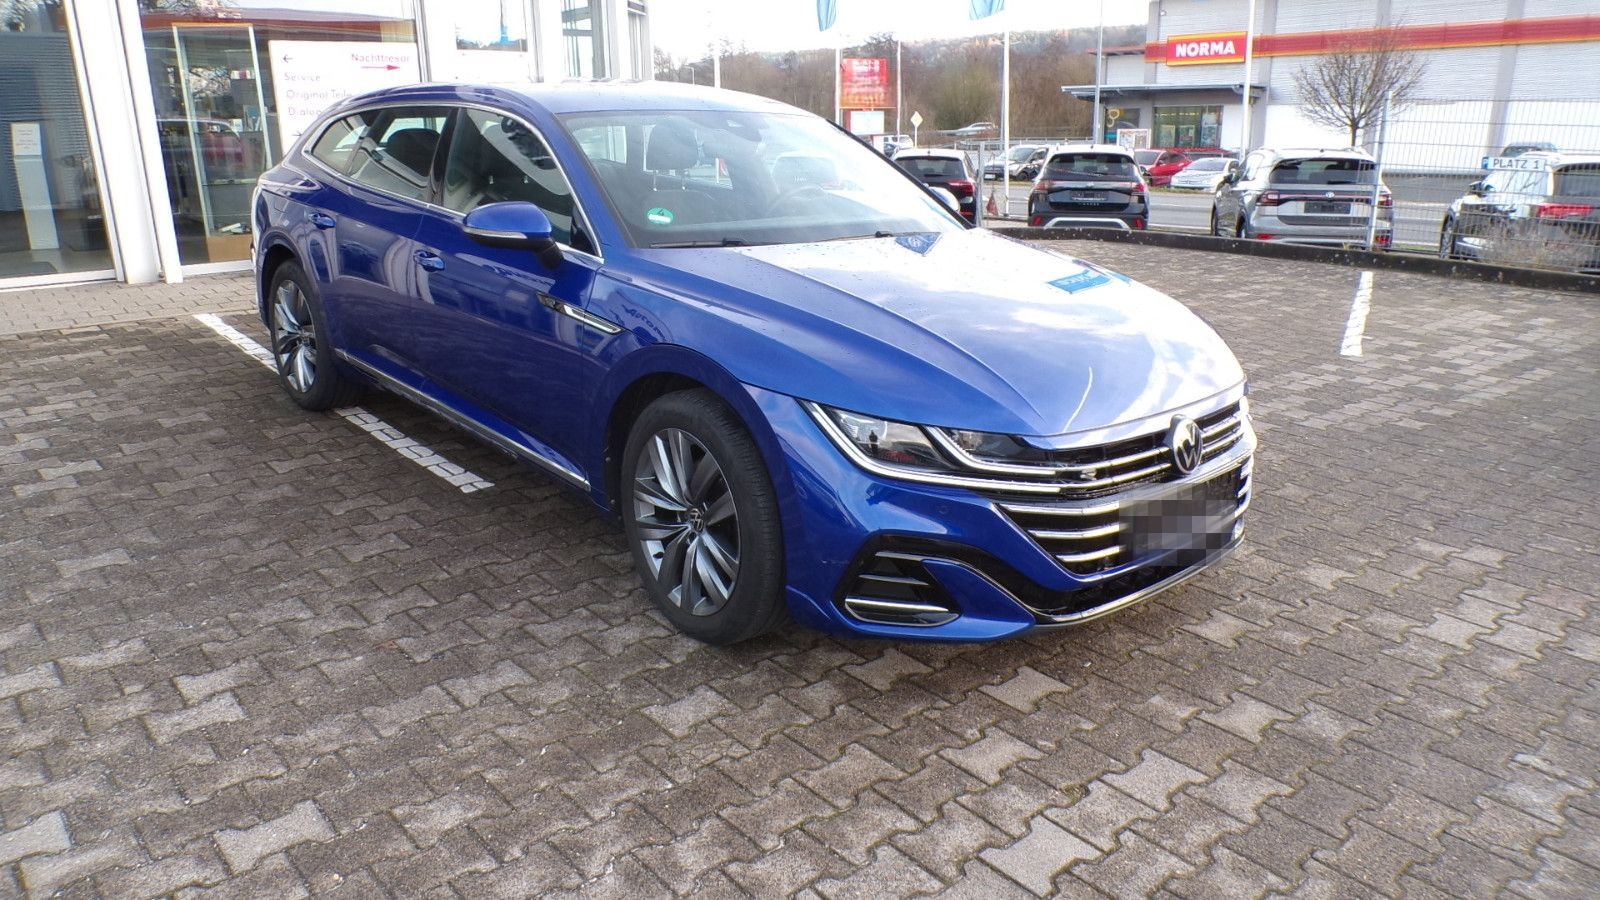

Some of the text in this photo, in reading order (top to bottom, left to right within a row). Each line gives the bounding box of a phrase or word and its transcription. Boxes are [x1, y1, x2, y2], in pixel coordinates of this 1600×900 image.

[1175, 40, 1236, 58] NORMA
[350, 53, 411, 63] Nachttresor
[284, 72, 321, 82] Service
[286, 89, 328, 101] Original
[1493, 158, 1539, 169] PLATZ 1
